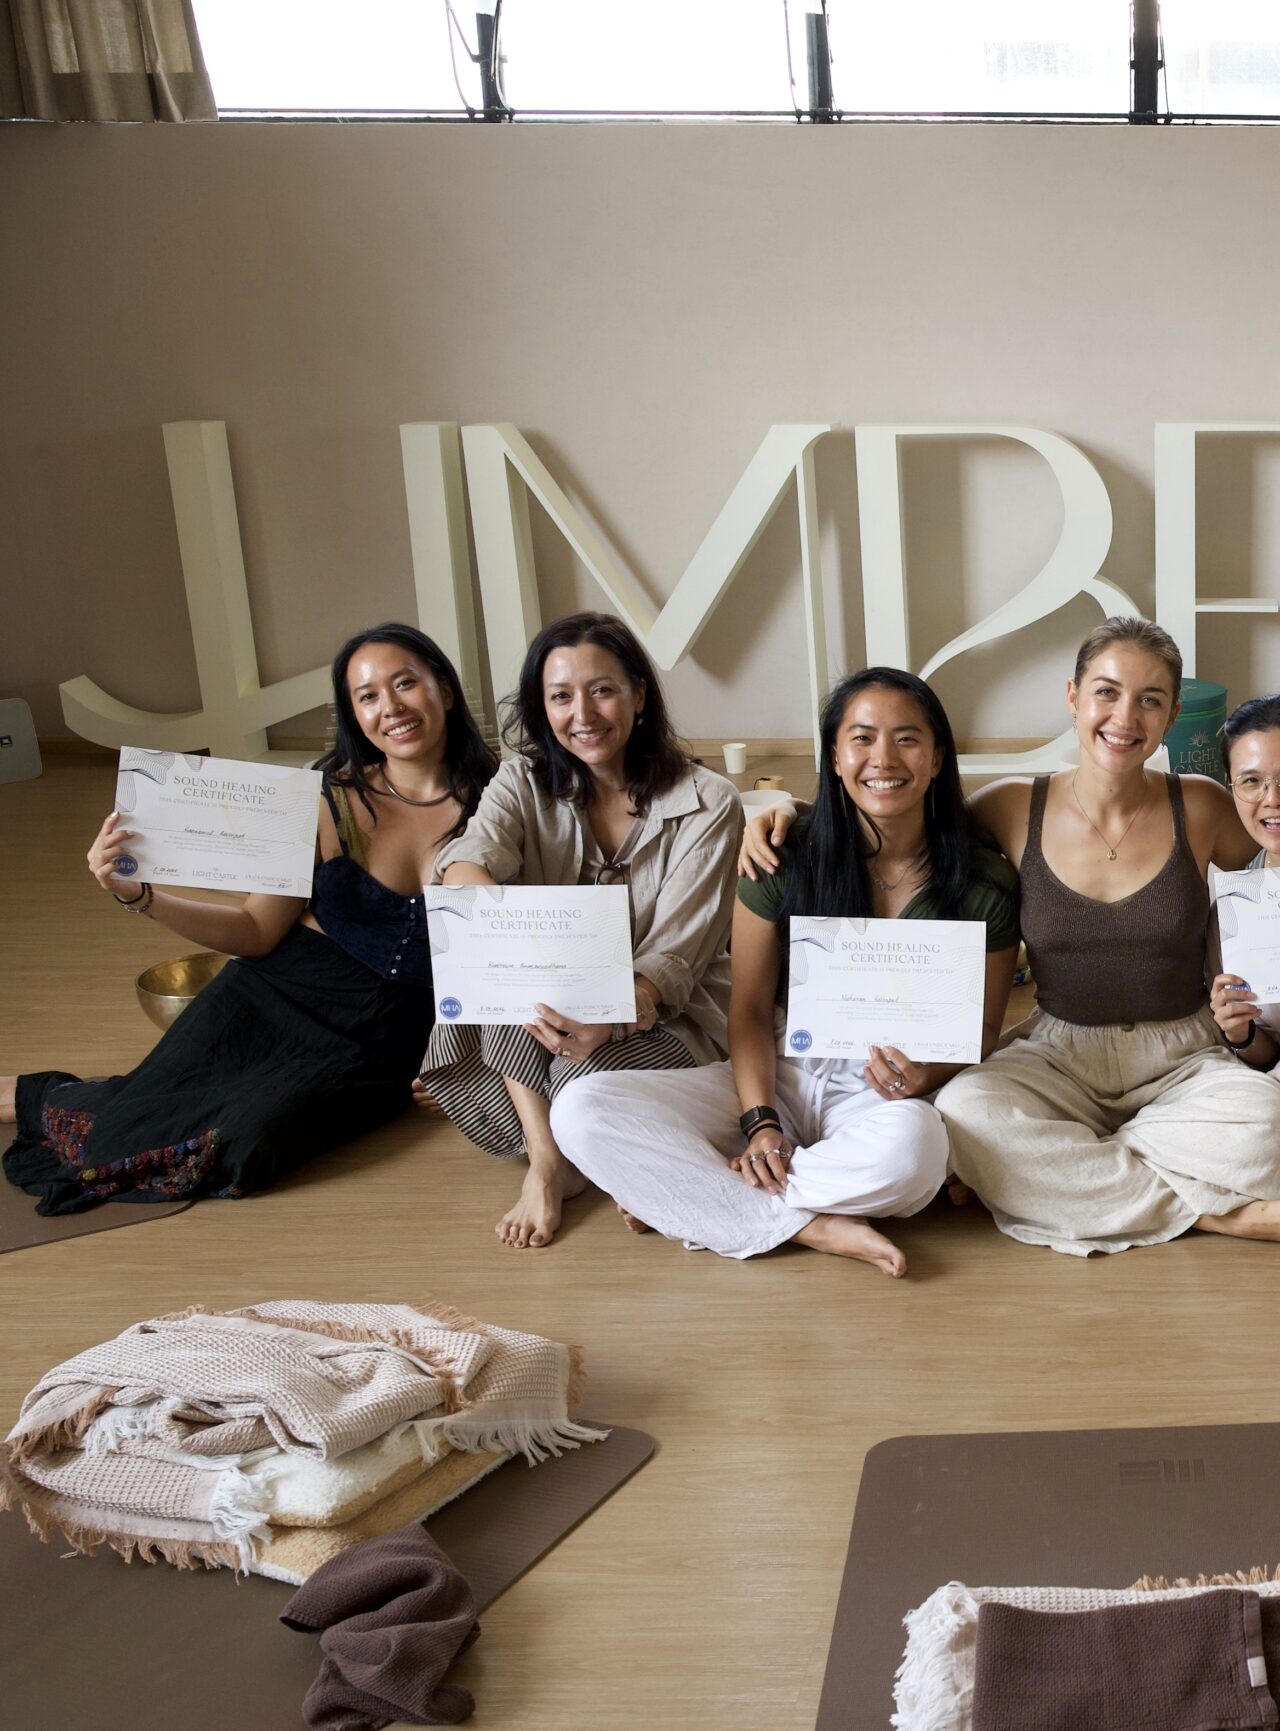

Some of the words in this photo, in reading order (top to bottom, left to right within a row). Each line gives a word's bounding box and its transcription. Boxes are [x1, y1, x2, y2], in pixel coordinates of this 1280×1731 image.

[1180, 747, 1216, 763] LIGHT
[173, 775, 218, 788] SOUND
[221, 780, 276, 796] HEALING
[182, 787, 265, 805] CERTIFICATE
[479, 909, 523, 919] SOUND
[526, 909, 582, 919] HEALING
[490, 920, 572, 930] CERTIFICATE
[841, 941, 884, 951] SOUND
[887, 942, 940, 953] HEALING
[850, 953, 930, 965] CERTIFICATE
